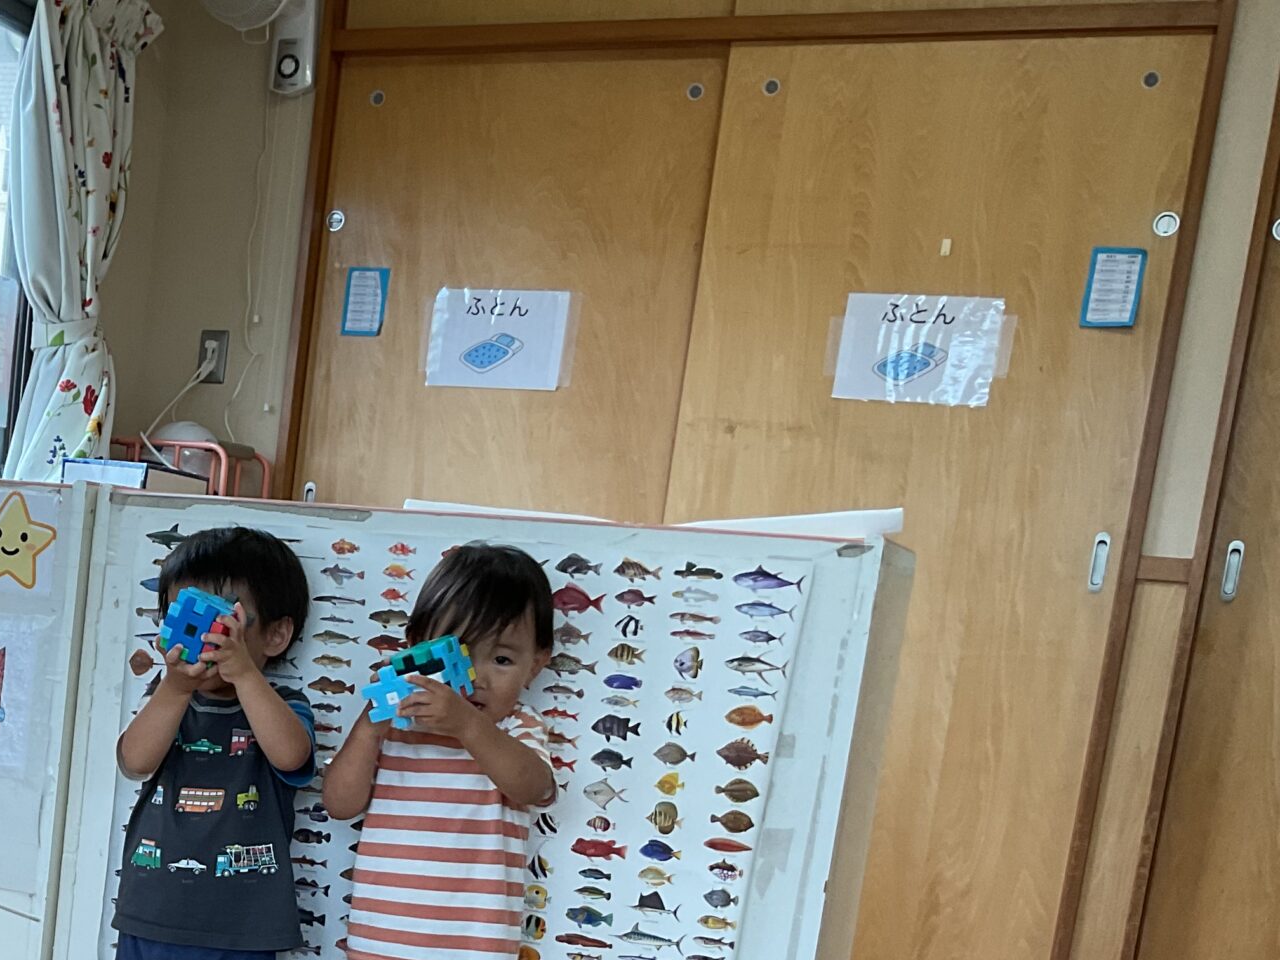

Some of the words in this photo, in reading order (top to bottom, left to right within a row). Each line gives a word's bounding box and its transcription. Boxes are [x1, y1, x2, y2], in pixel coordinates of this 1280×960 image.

[465, 296, 529, 317] ふとん
[881, 302, 956, 325] ふとん
